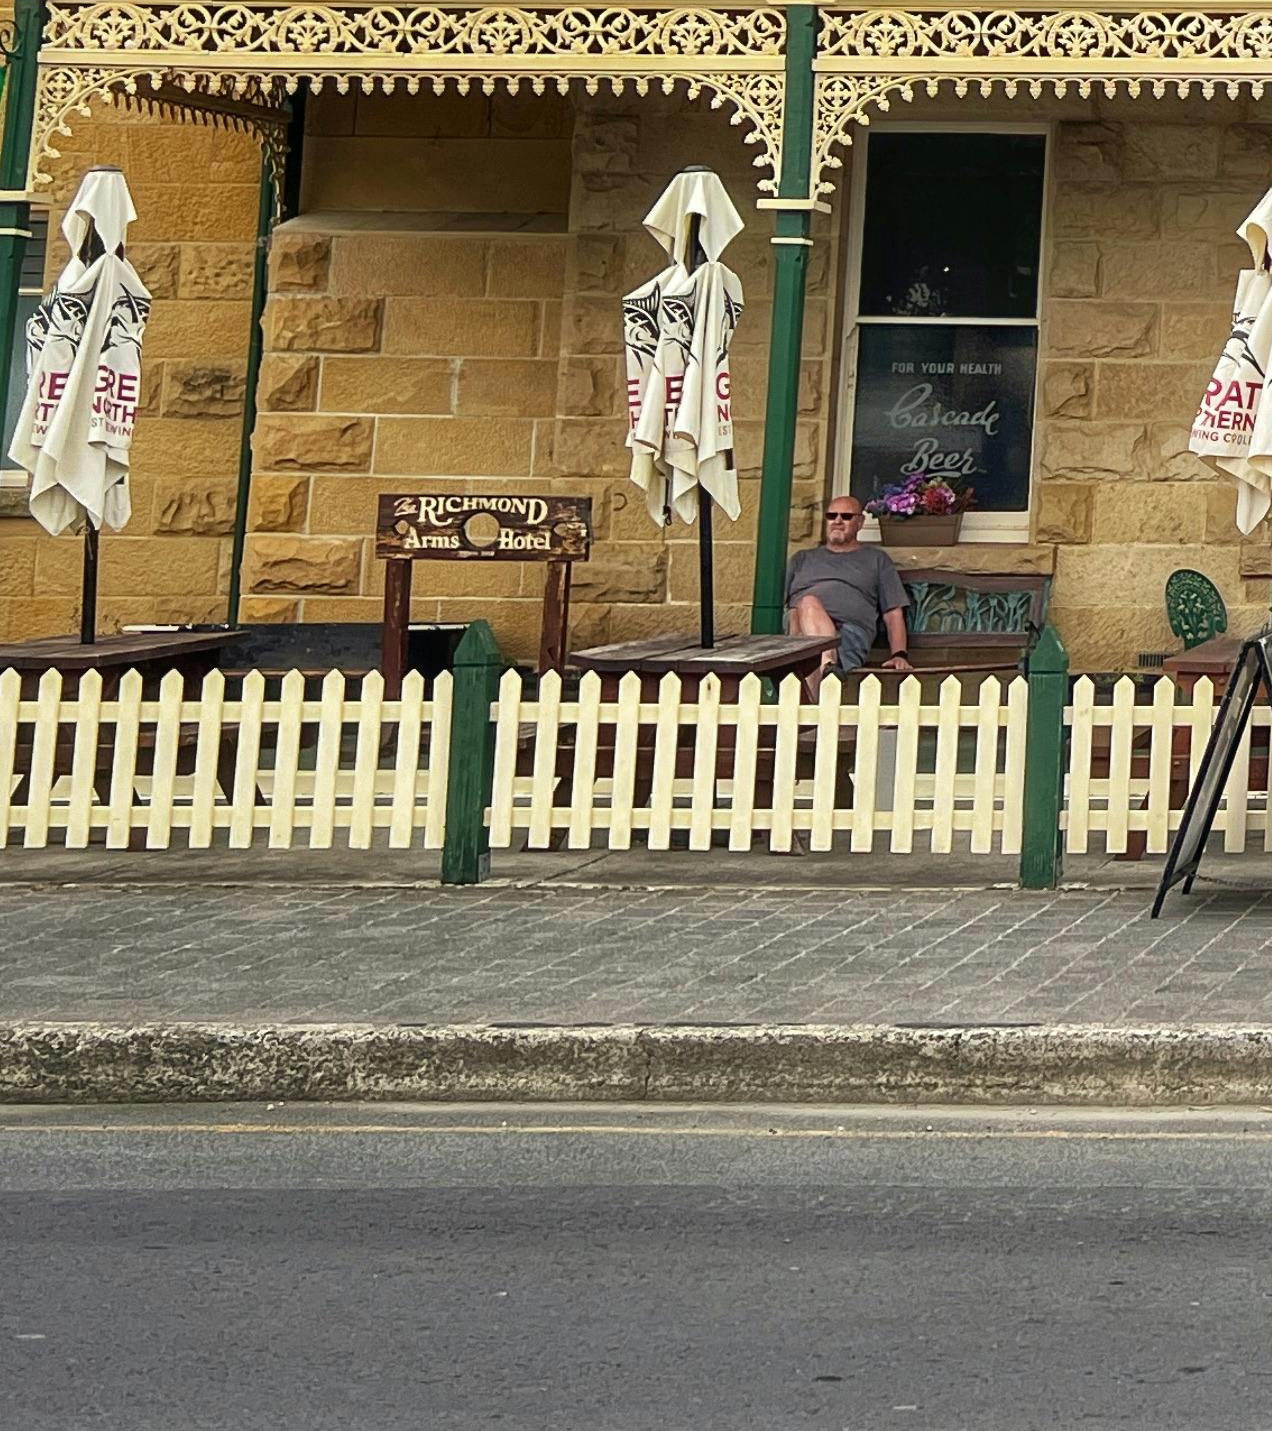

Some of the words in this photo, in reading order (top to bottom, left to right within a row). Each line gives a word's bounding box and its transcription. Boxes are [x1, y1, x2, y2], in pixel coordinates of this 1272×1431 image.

[892, 362, 914, 374] FOR
[921, 362, 956, 374] YOUR
[960, 362, 1002, 375] HEALTH
[883, 382, 1000, 436] Cascade
[900, 437, 977, 475] Beer
[416, 496, 549, 527] RICHMOND
[404, 525, 460, 550] Arms
[497, 527, 551, 551] Hotel
